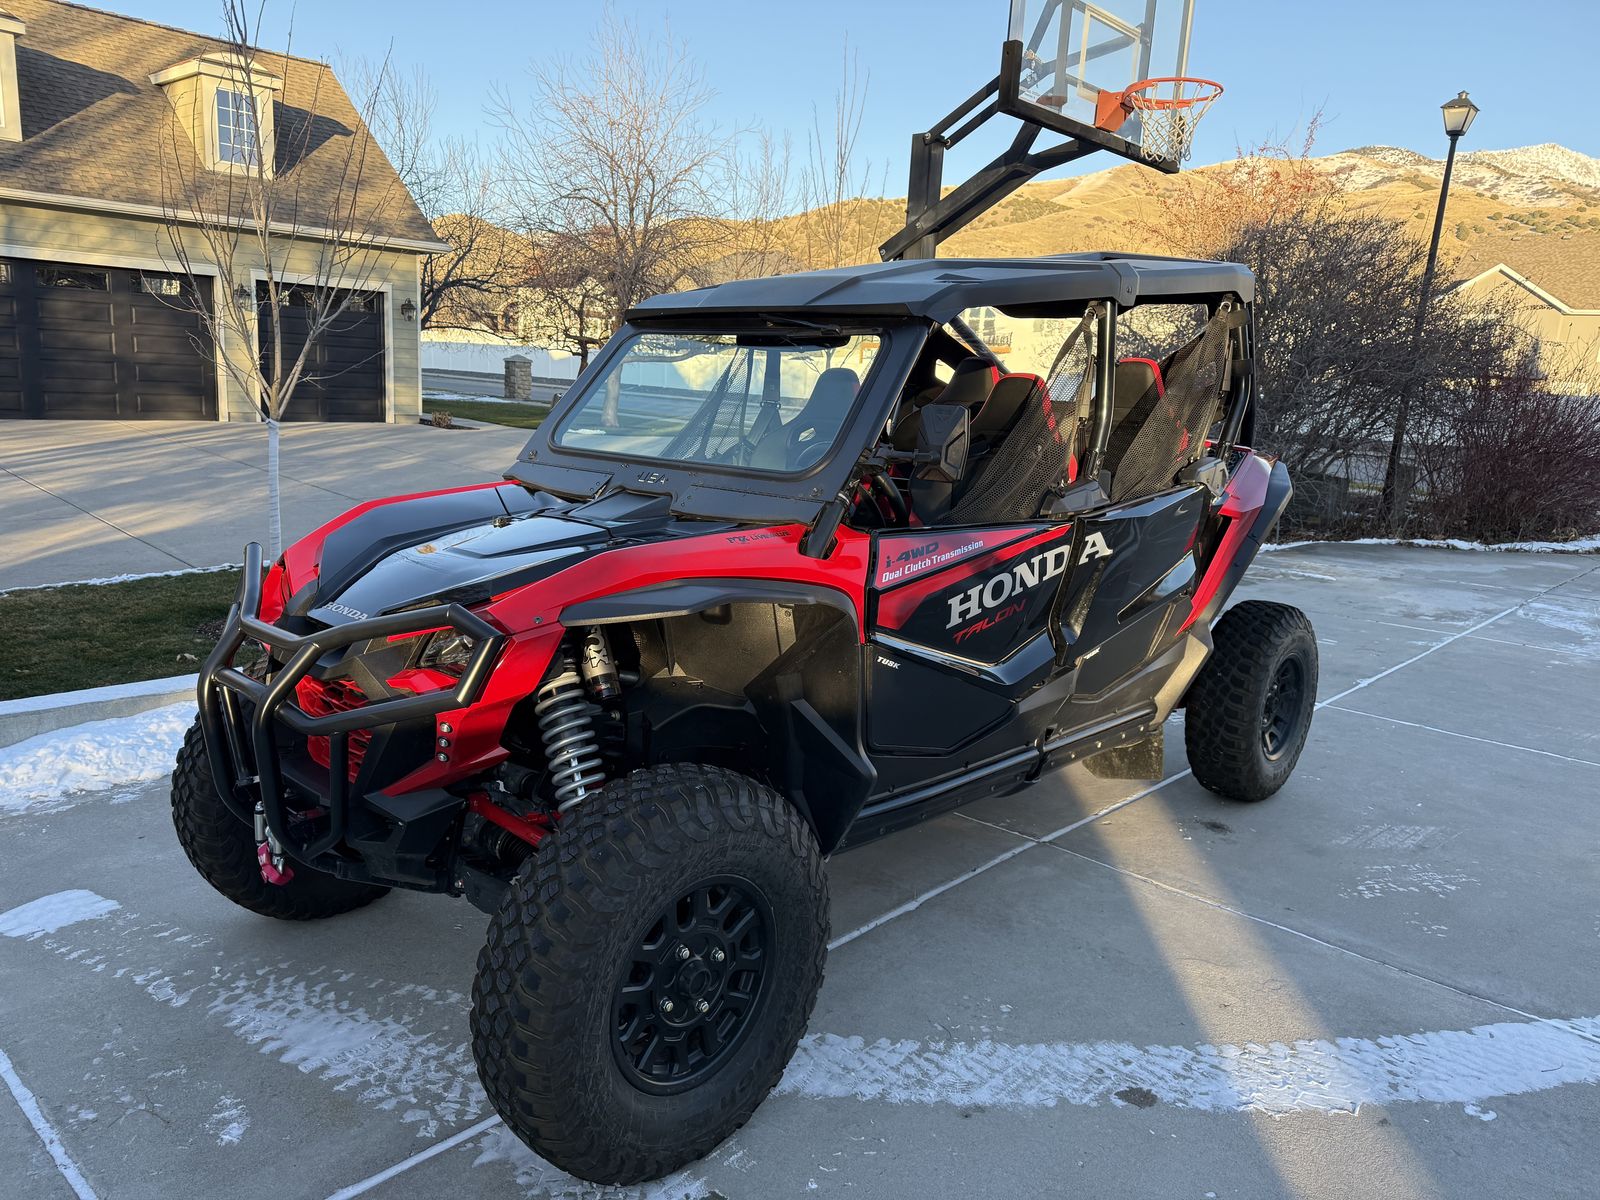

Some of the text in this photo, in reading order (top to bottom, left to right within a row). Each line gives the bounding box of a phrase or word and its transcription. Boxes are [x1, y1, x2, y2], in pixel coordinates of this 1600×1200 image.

[882, 540, 984, 583] Dual Clutch Transmission
[945, 531, 1113, 630] HONDA
[322, 601, 369, 620] HONDA
[952, 600, 1025, 645] TALON
[877, 655, 901, 670] TUSK
